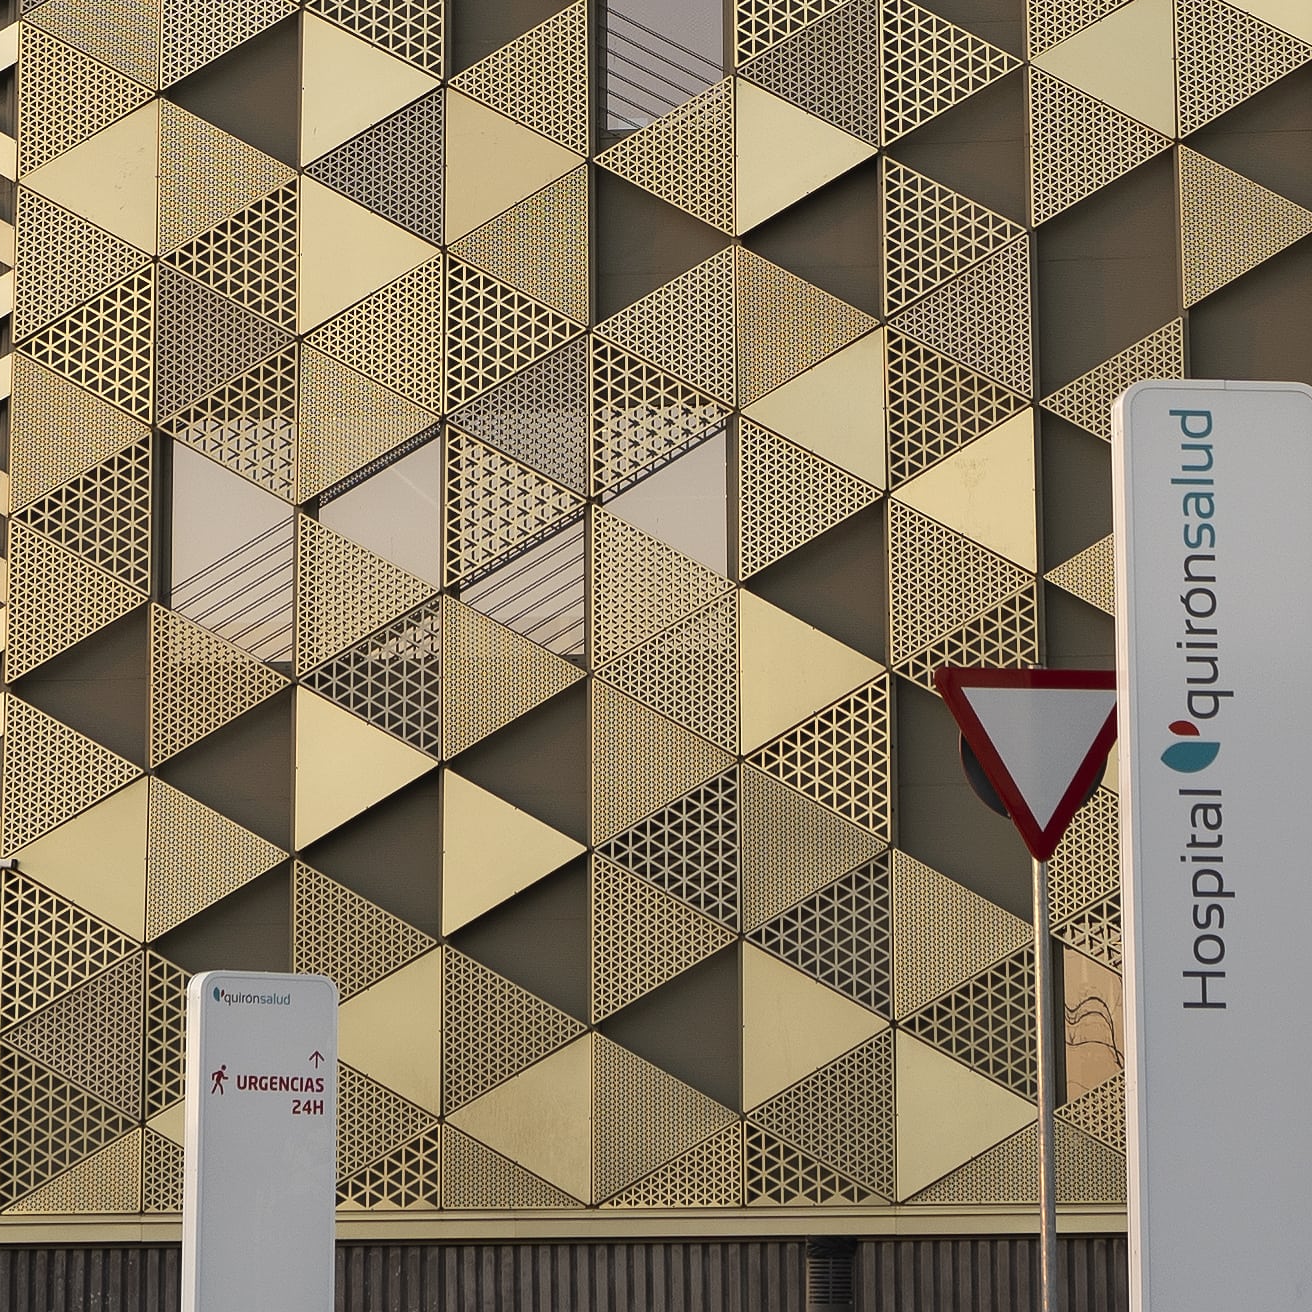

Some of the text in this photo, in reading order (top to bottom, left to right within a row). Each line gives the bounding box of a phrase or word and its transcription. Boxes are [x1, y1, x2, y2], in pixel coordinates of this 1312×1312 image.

[1170, 408, 1236, 1011] Hospital quirónsalud
[236, 1075, 325, 1093] URGENCIAS
[291, 1099, 324, 1115] 24H
